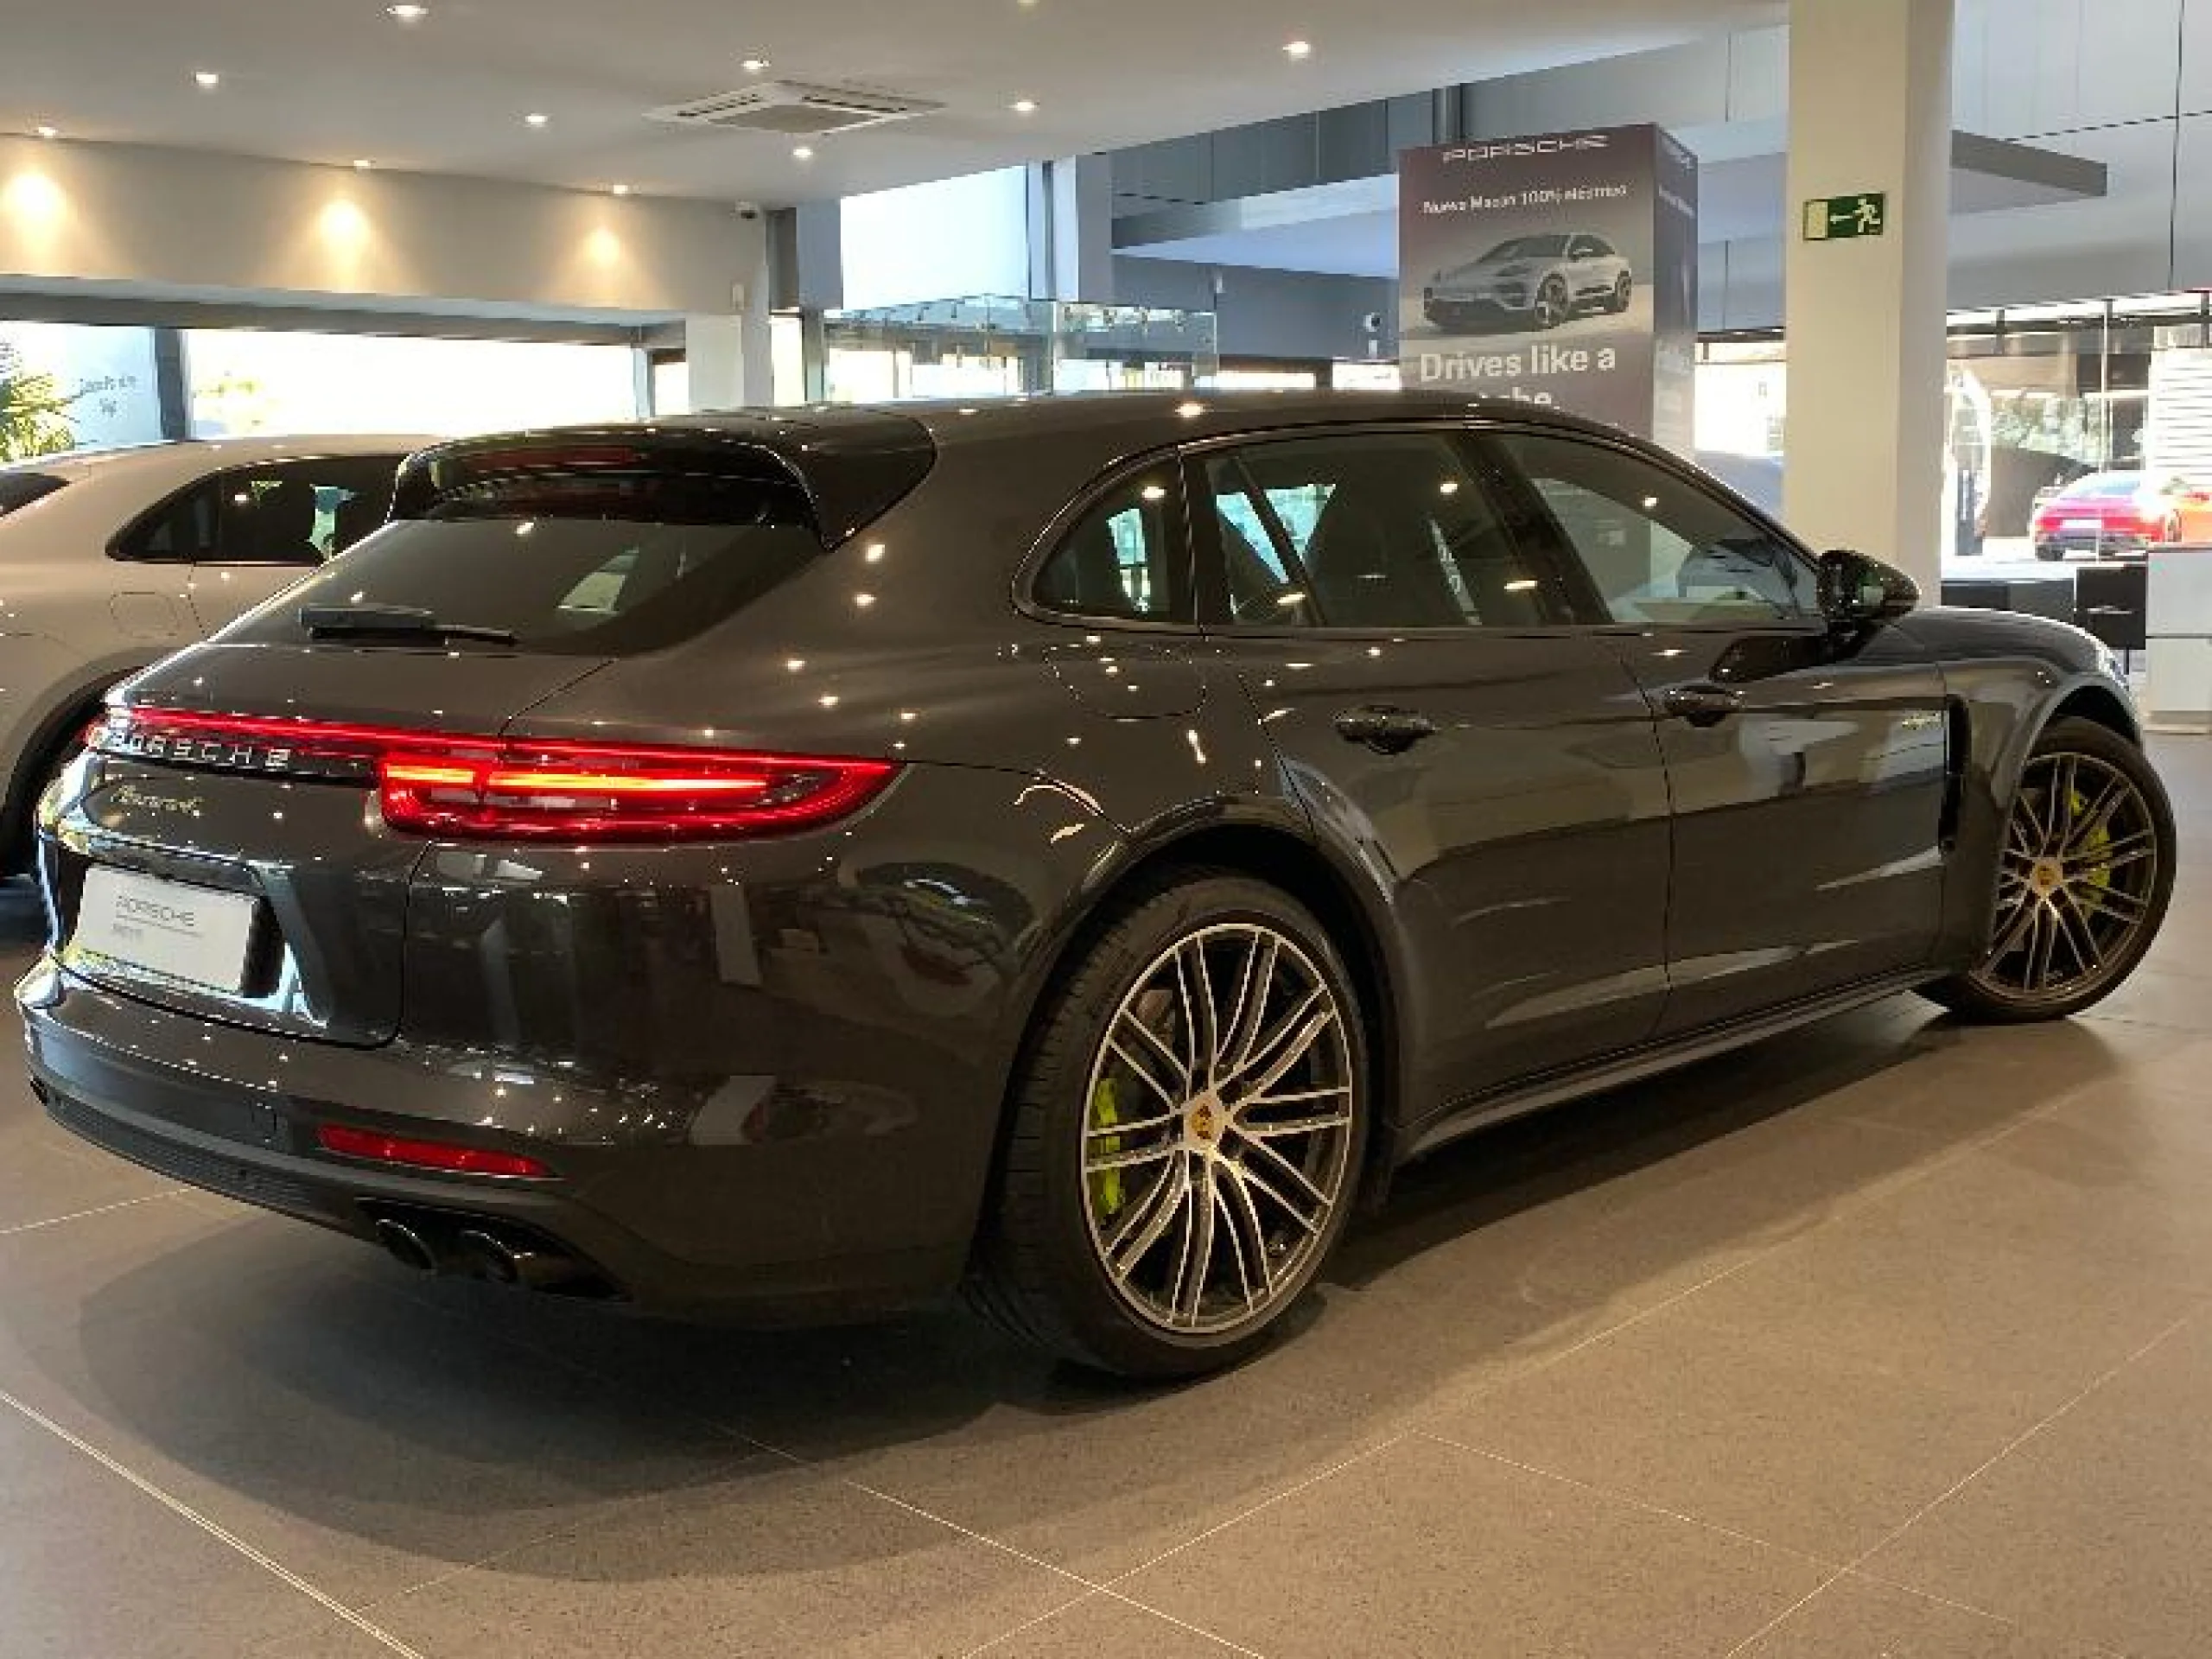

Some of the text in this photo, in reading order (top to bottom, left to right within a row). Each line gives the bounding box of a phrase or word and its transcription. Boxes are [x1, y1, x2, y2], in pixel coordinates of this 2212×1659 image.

[1442, 134, 1610, 163] PORSCHE
[1421, 345, 1616, 382] Drives like a
